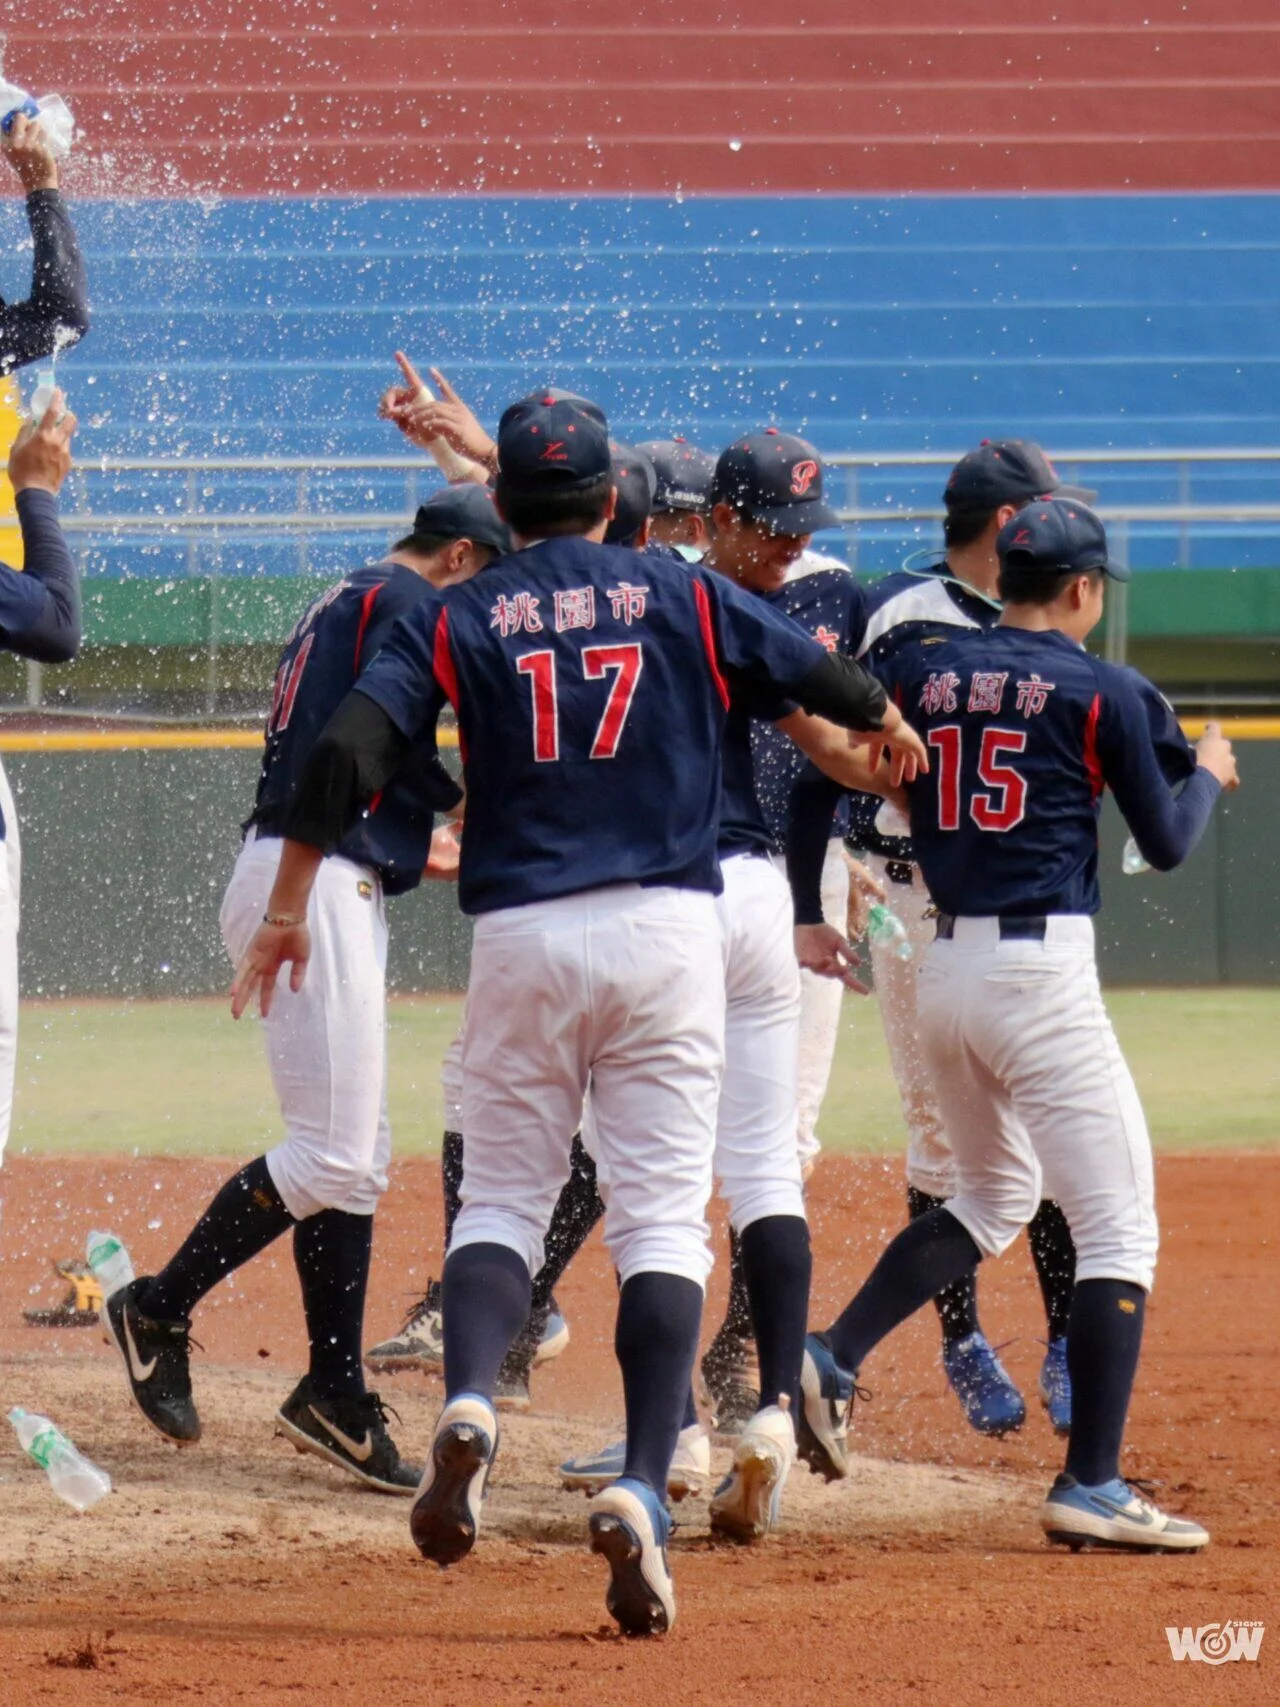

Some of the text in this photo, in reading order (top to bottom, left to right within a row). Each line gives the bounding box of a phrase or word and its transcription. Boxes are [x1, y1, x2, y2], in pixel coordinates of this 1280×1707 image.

[490, 581, 650, 638] 桃園市
[515, 642, 644, 763] 17
[919, 670, 1056, 720] 桃園市
[927, 725, 1028, 833] 15
